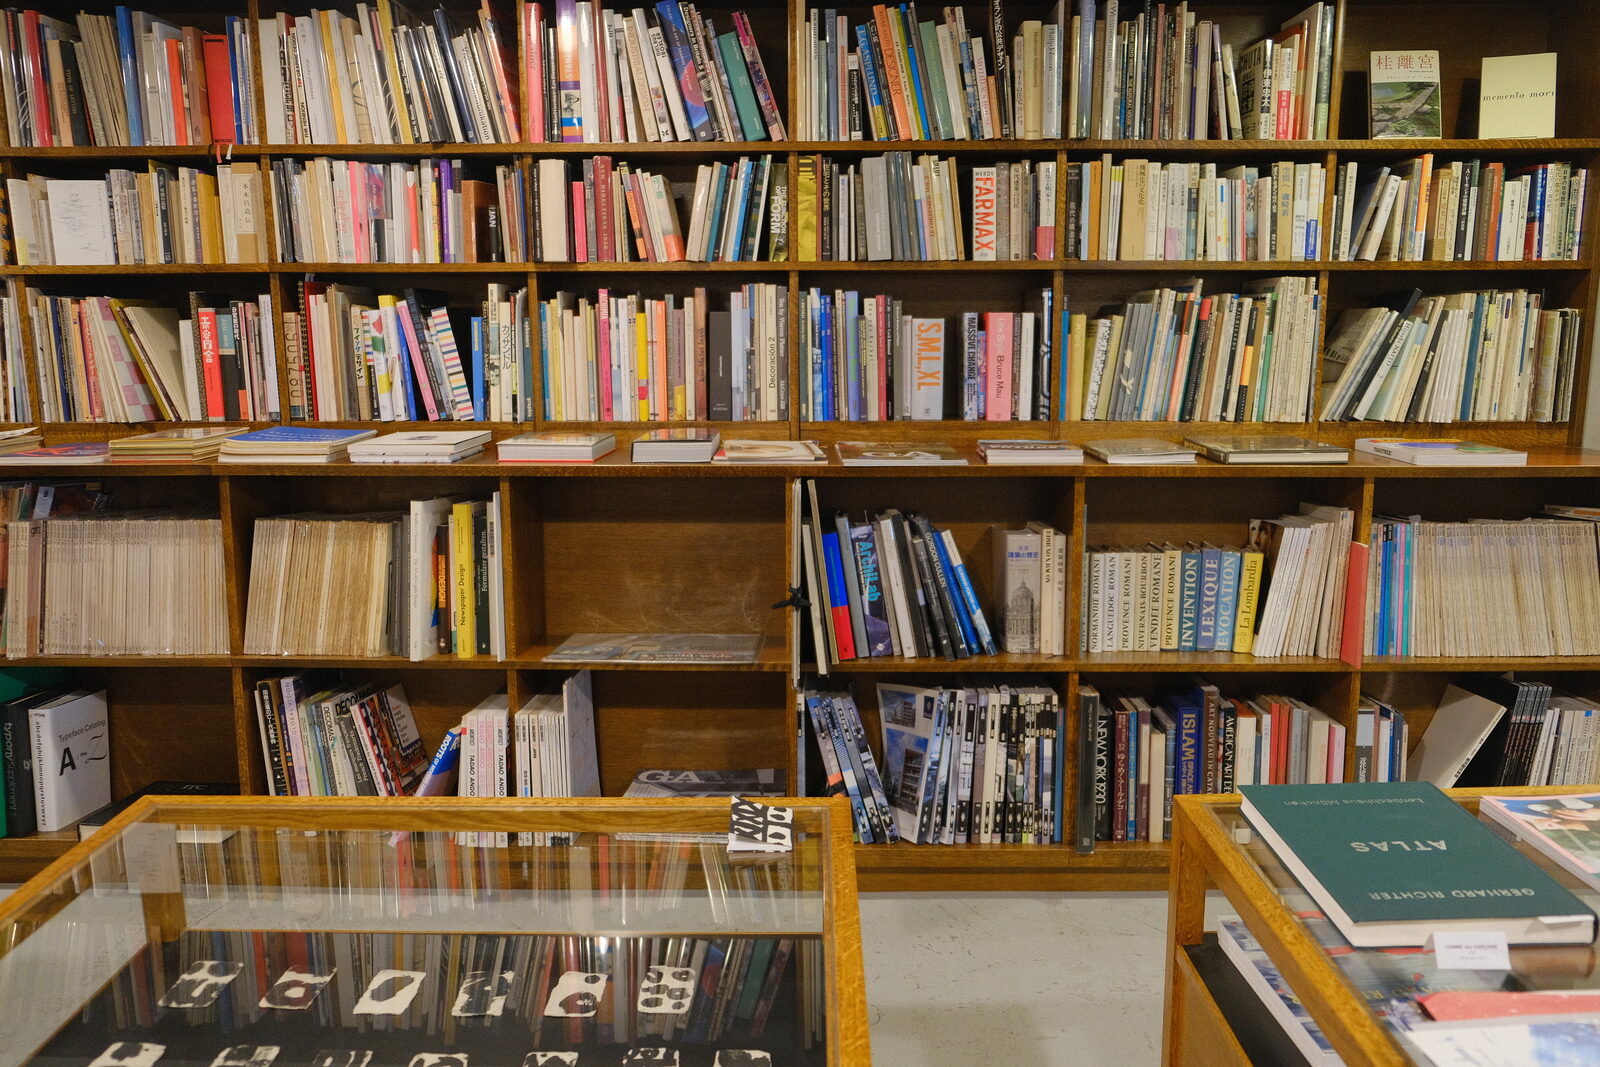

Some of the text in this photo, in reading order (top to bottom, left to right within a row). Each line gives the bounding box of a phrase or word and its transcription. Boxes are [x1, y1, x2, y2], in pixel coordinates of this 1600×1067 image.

[683, 6, 695, 37] Designers
[693, 44, 702, 64] Britain
[1376, 54, 1435, 71] 桂離宮
[885, 47, 901, 97] DESIGNER
[770, 195, 781, 234] FORM
[975, 176, 995, 252] FARMAX
[967, 317, 976, 381] MASSIVE CHANGE
[996, 317, 1006, 333] Life
[767, 343, 776, 389] Decoración
[914, 322, 942, 391] S,M,L,XL
[996, 355, 1005, 380] Bruce
[996, 380, 1005, 399] Mau
[480, 529, 488, 592] Formulare gestalten.
[858, 541, 881, 602] ArchiLab
[925, 532, 946, 588] GORDON CULLEN
[457, 563, 467, 626] Newspaper Design
[1091, 557, 1100, 650] NORMANDIE ROMANE
[1107, 556, 1116, 648] LANGUEDOC ROMAN
[1121, 557, 1131, 649] PROVENCE ROMANE
[1138, 555, 1148, 650] NIVERNAIS-BOURBON
[1149, 554, 1161, 648] VENDÉE ROMANE
[1165, 553, 1176, 647] PROVENCE ROMANE
[1181, 558, 1198, 648] INVENTION
[1201, 558, 1219, 638] LEXIQUE
[1216, 556, 1236, 647] EVOCATION
[1240, 559, 1258, 629] La Lombardia
[58, 719, 106, 743] Typeface Catalog
[323, 706, 336, 742] DECOMAS
[437, 734, 452, 764] ROOTS
[1181, 713, 1195, 761] ISLAM
[1224, 715, 1235, 761] AMERICAN
[59, 746, 77, 777] A
[637, 770, 706, 784] GA
[1095, 719, 1107, 804] NEW YORK 1930
[1207, 760, 1213, 770] IN
[1223, 762, 1234, 779] ART
[1350, 839, 1449, 853] ATLAS
[1368, 887, 1536, 900] GERHARD RICHTER
